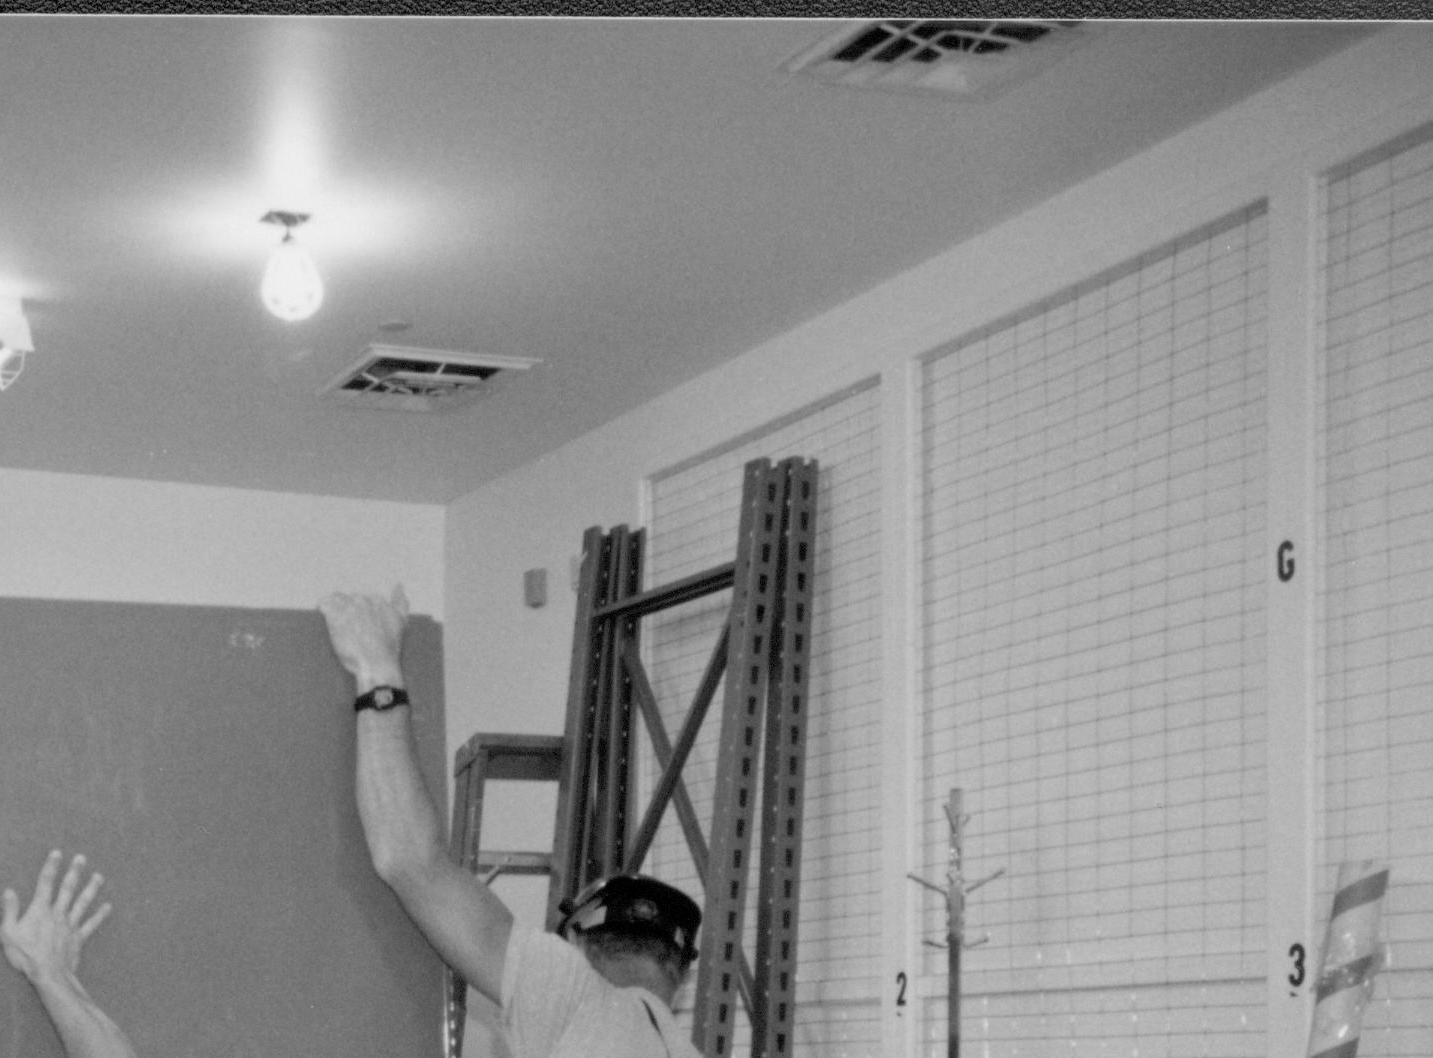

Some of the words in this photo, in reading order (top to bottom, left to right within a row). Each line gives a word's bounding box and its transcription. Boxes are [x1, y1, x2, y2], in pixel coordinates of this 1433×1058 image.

[1277, 540, 1295, 582] G
[1288, 943, 1305, 987] 3
[896, 971, 907, 1006] 2
